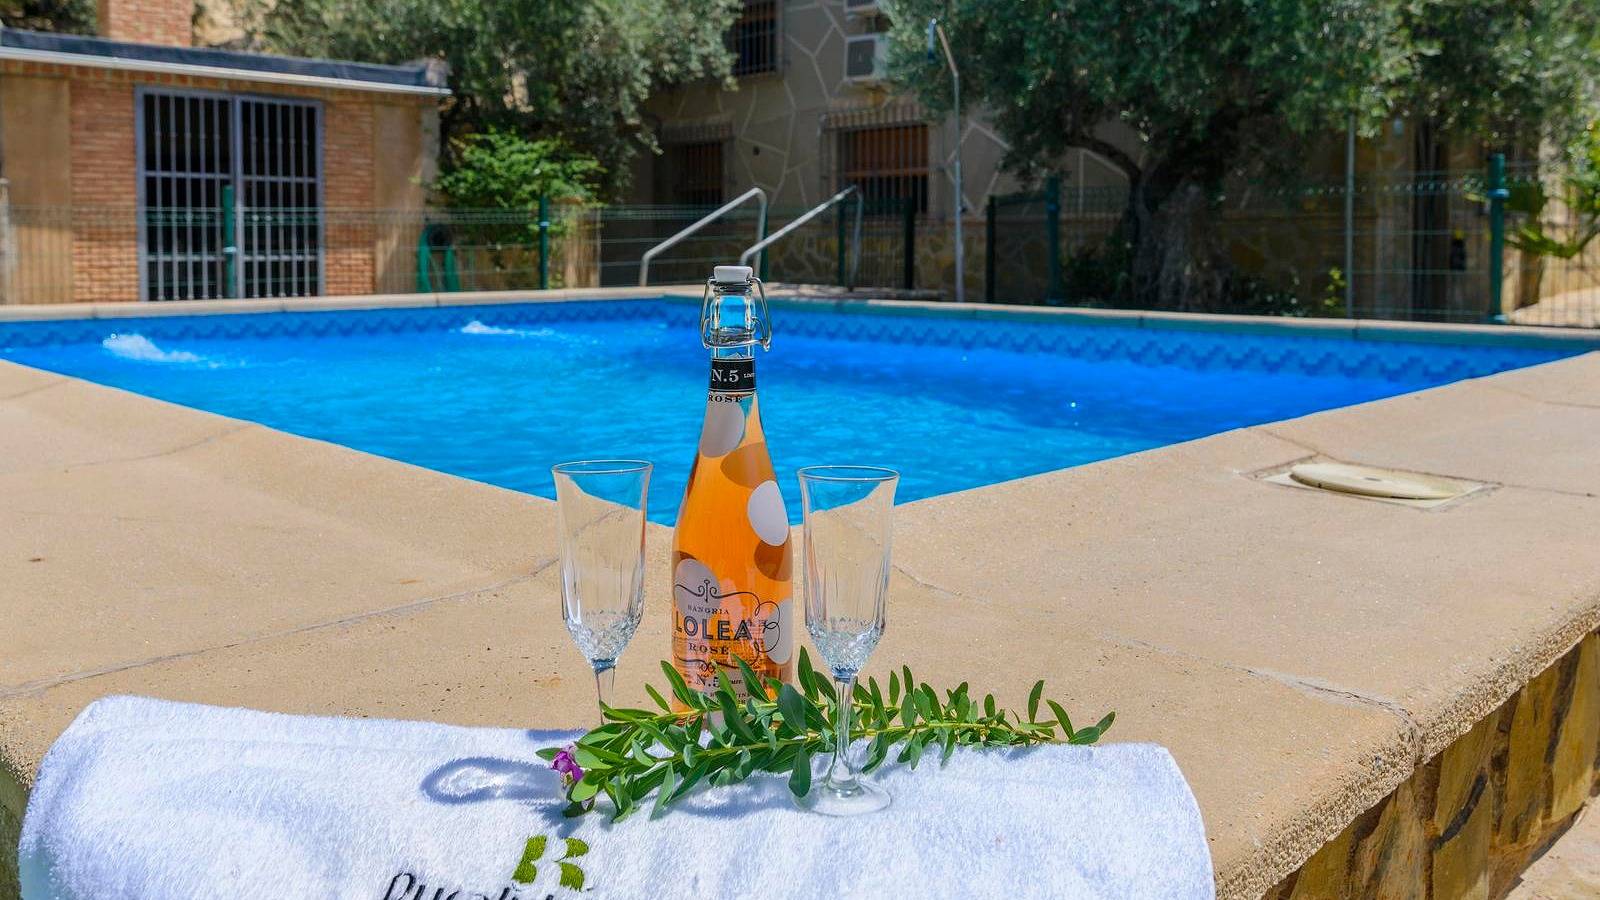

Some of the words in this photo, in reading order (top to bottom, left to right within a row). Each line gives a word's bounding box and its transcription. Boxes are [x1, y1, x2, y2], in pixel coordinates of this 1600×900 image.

[711, 368, 740, 383] N.5
[687, 603, 730, 616] SANGRIA
[675, 610, 754, 641] LOLEA
